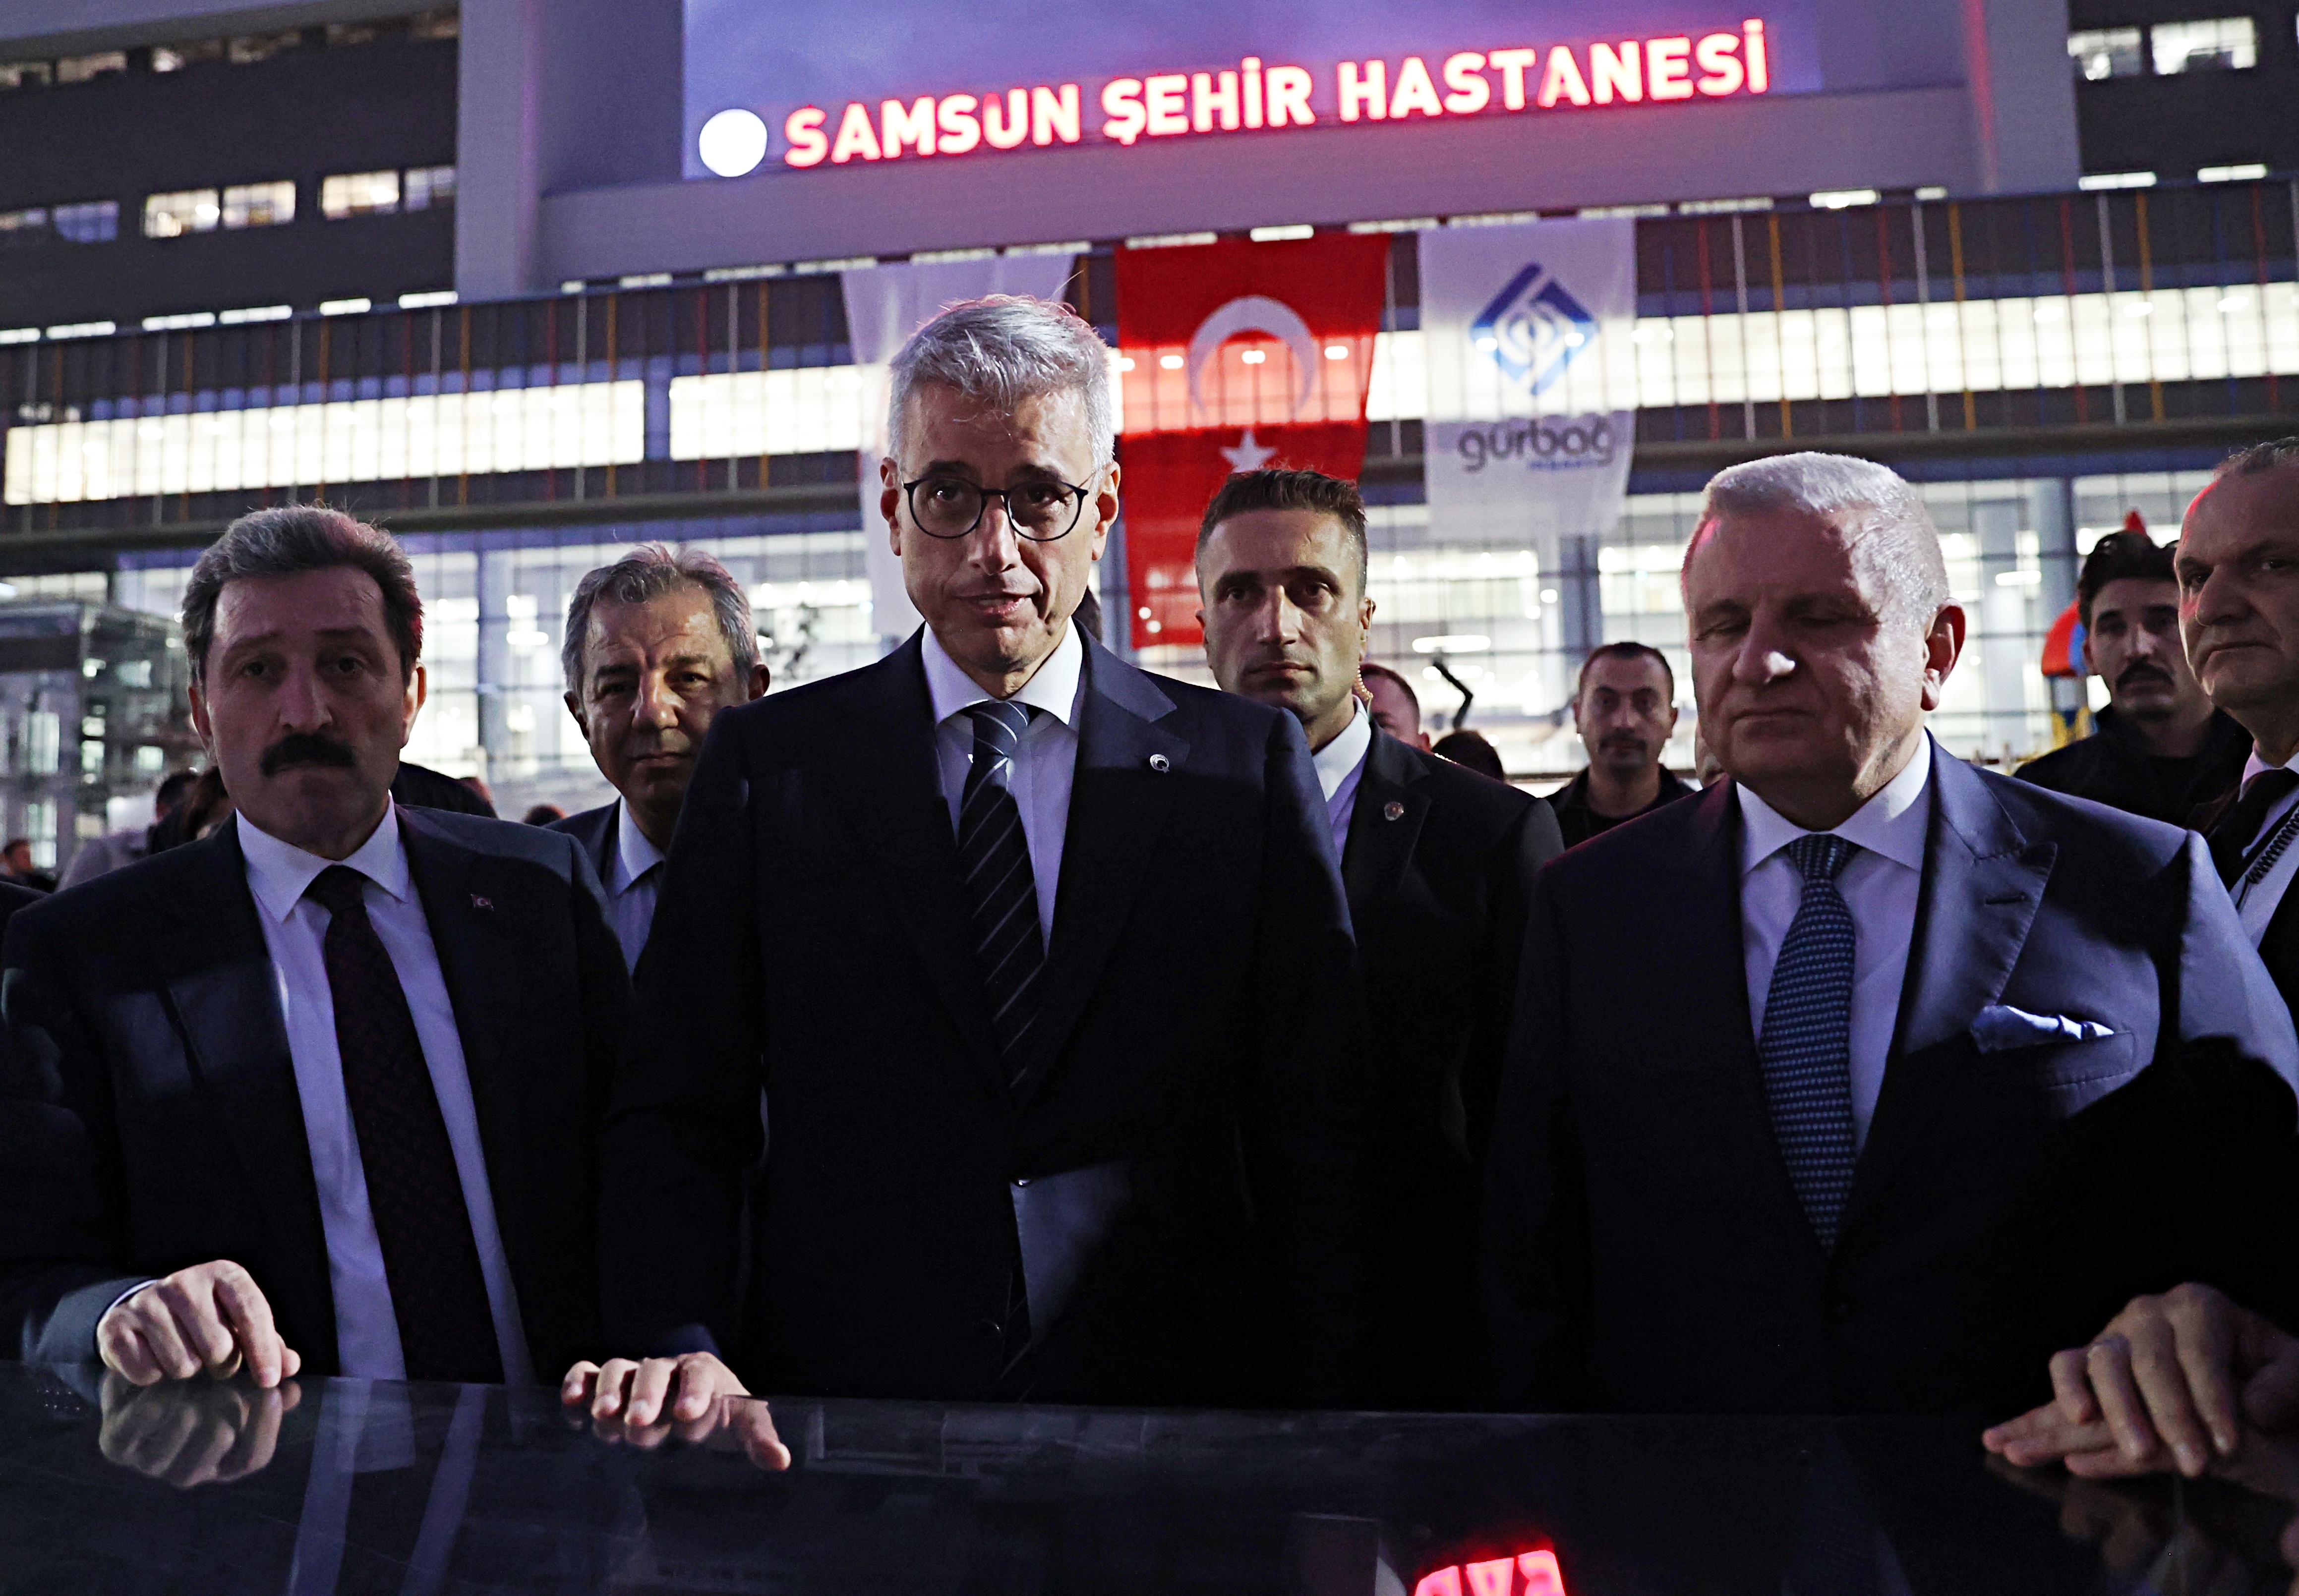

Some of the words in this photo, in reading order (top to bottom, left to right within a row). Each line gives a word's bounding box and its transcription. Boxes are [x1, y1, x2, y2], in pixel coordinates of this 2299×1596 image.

[785, 84, 1082, 167] SAMSUN
[1101, 57, 1316, 145] ŞEHİR
[1337, 19, 1769, 122] HASTANESİ
